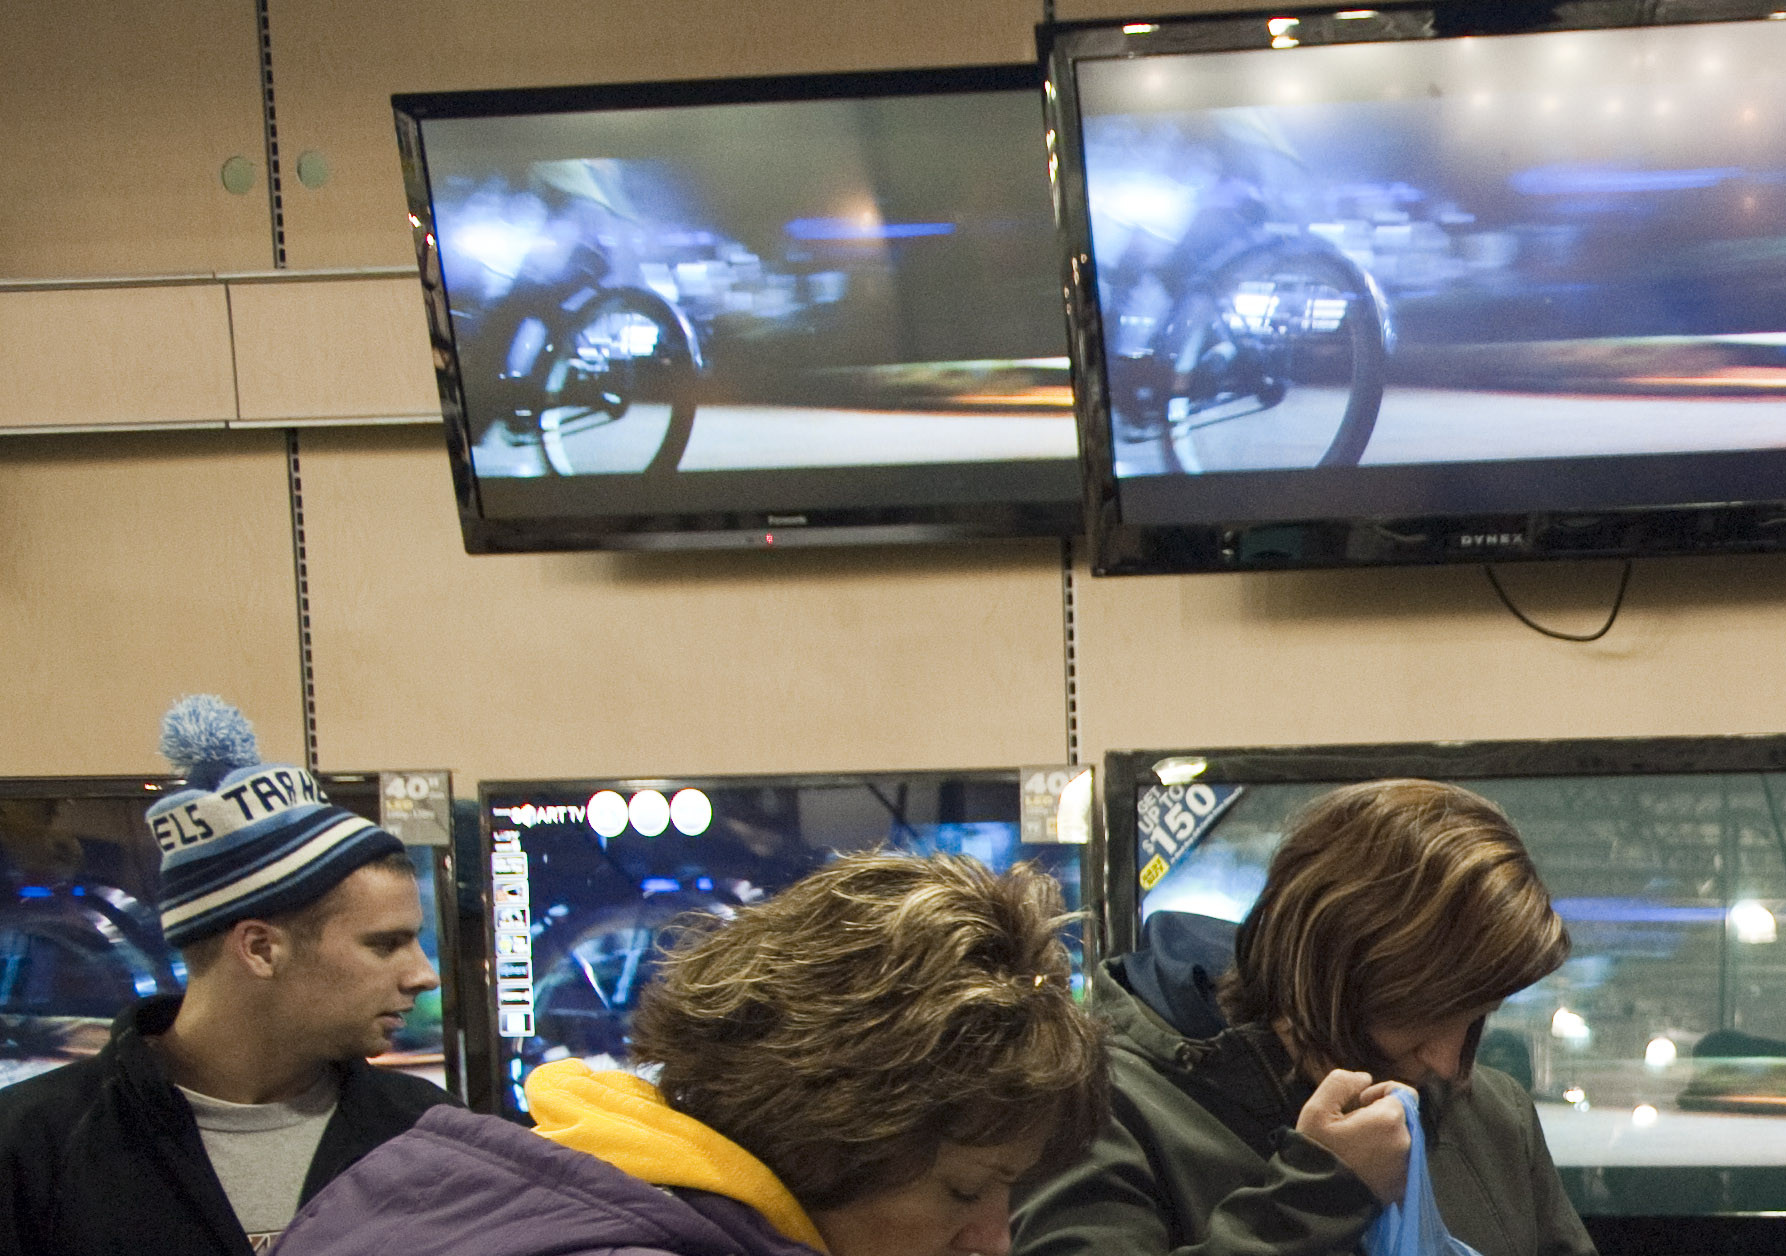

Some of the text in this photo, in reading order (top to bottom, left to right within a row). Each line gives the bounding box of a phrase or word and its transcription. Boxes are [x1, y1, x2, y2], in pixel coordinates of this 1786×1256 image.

[1461, 533, 1524, 546] DYNEX
[152, 803, 214, 852] ELS
[222, 771, 297, 821] TAR
[567, 805, 587, 825] TV
[1137, 785, 1162, 814] GET
[1138, 783, 1184, 835] UP TO
[1142, 783, 1217, 856] $150
